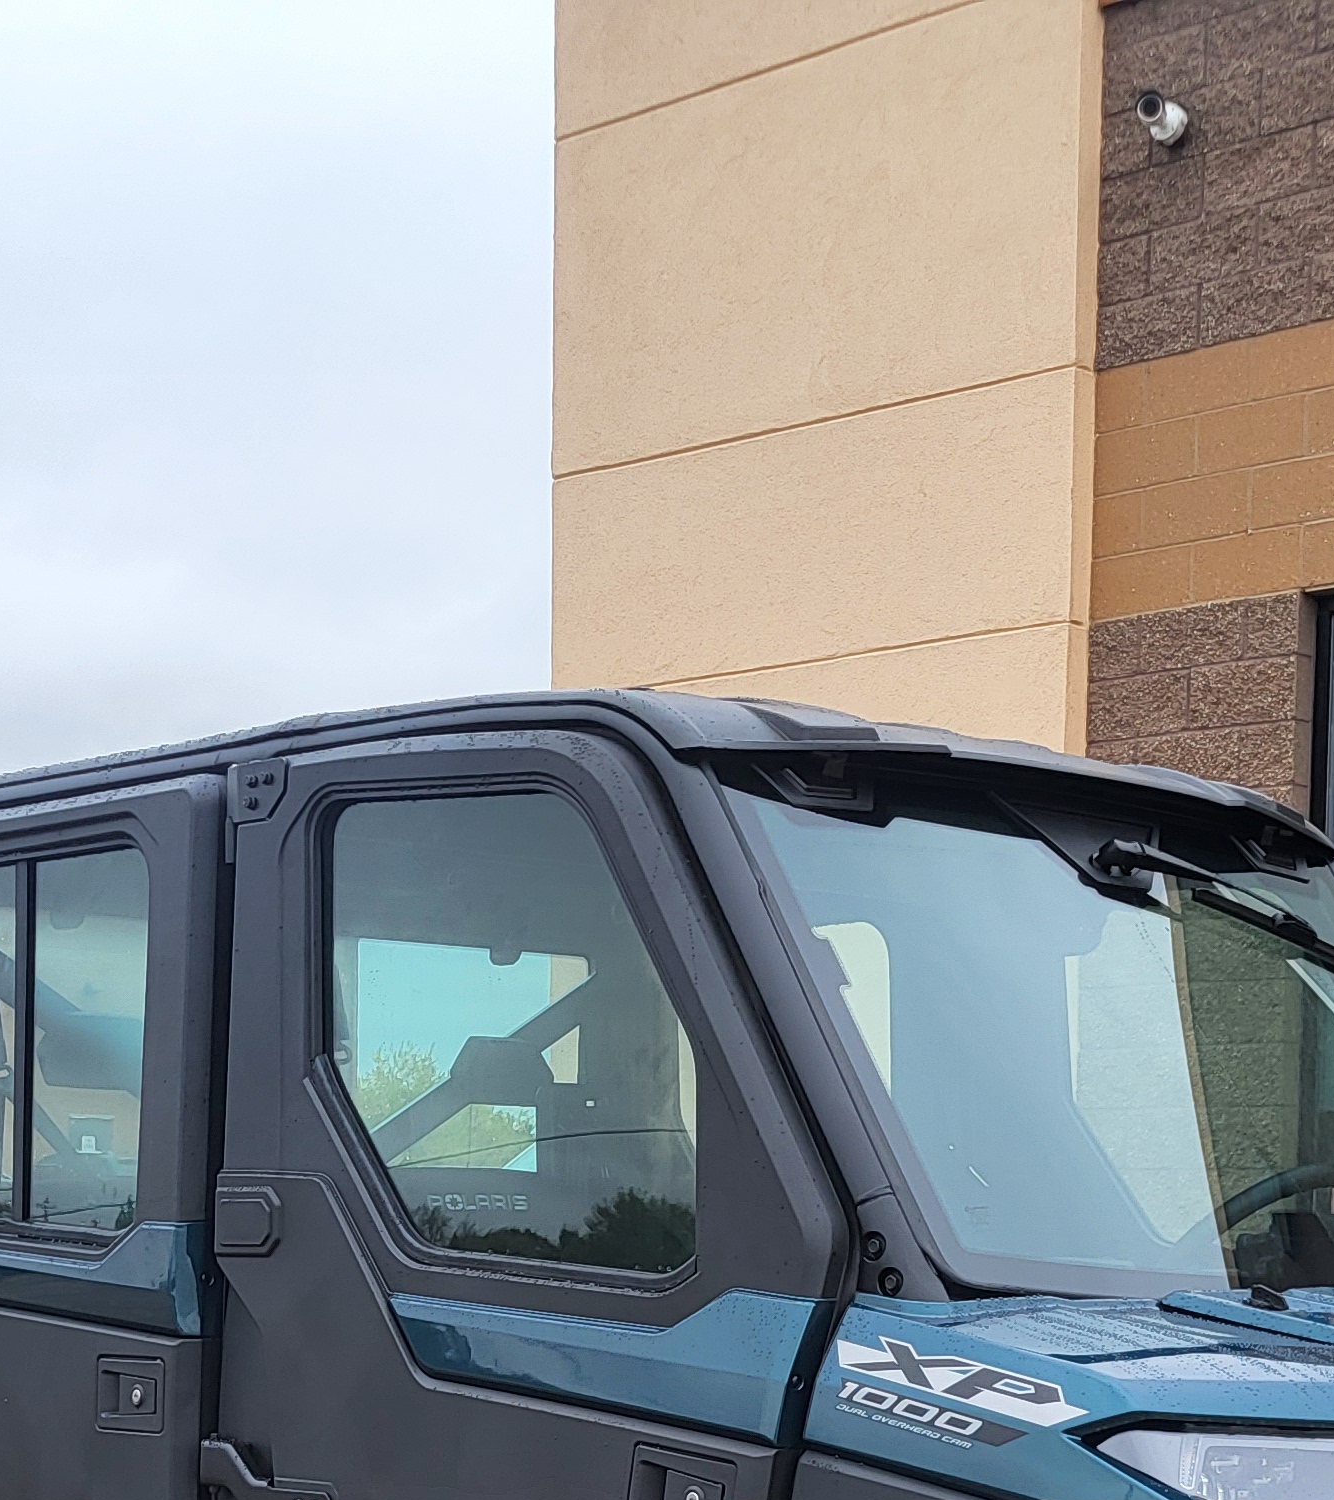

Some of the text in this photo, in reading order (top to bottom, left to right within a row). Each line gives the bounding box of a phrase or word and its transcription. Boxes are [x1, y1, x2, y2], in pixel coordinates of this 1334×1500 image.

[426, 1193, 529, 1211] POLARIS
[842, 1336, 1065, 1405] XP
[835, 1403, 973, 1449] DUAL OVERHEAD CAM
[837, 1381, 983, 1435] 1000
